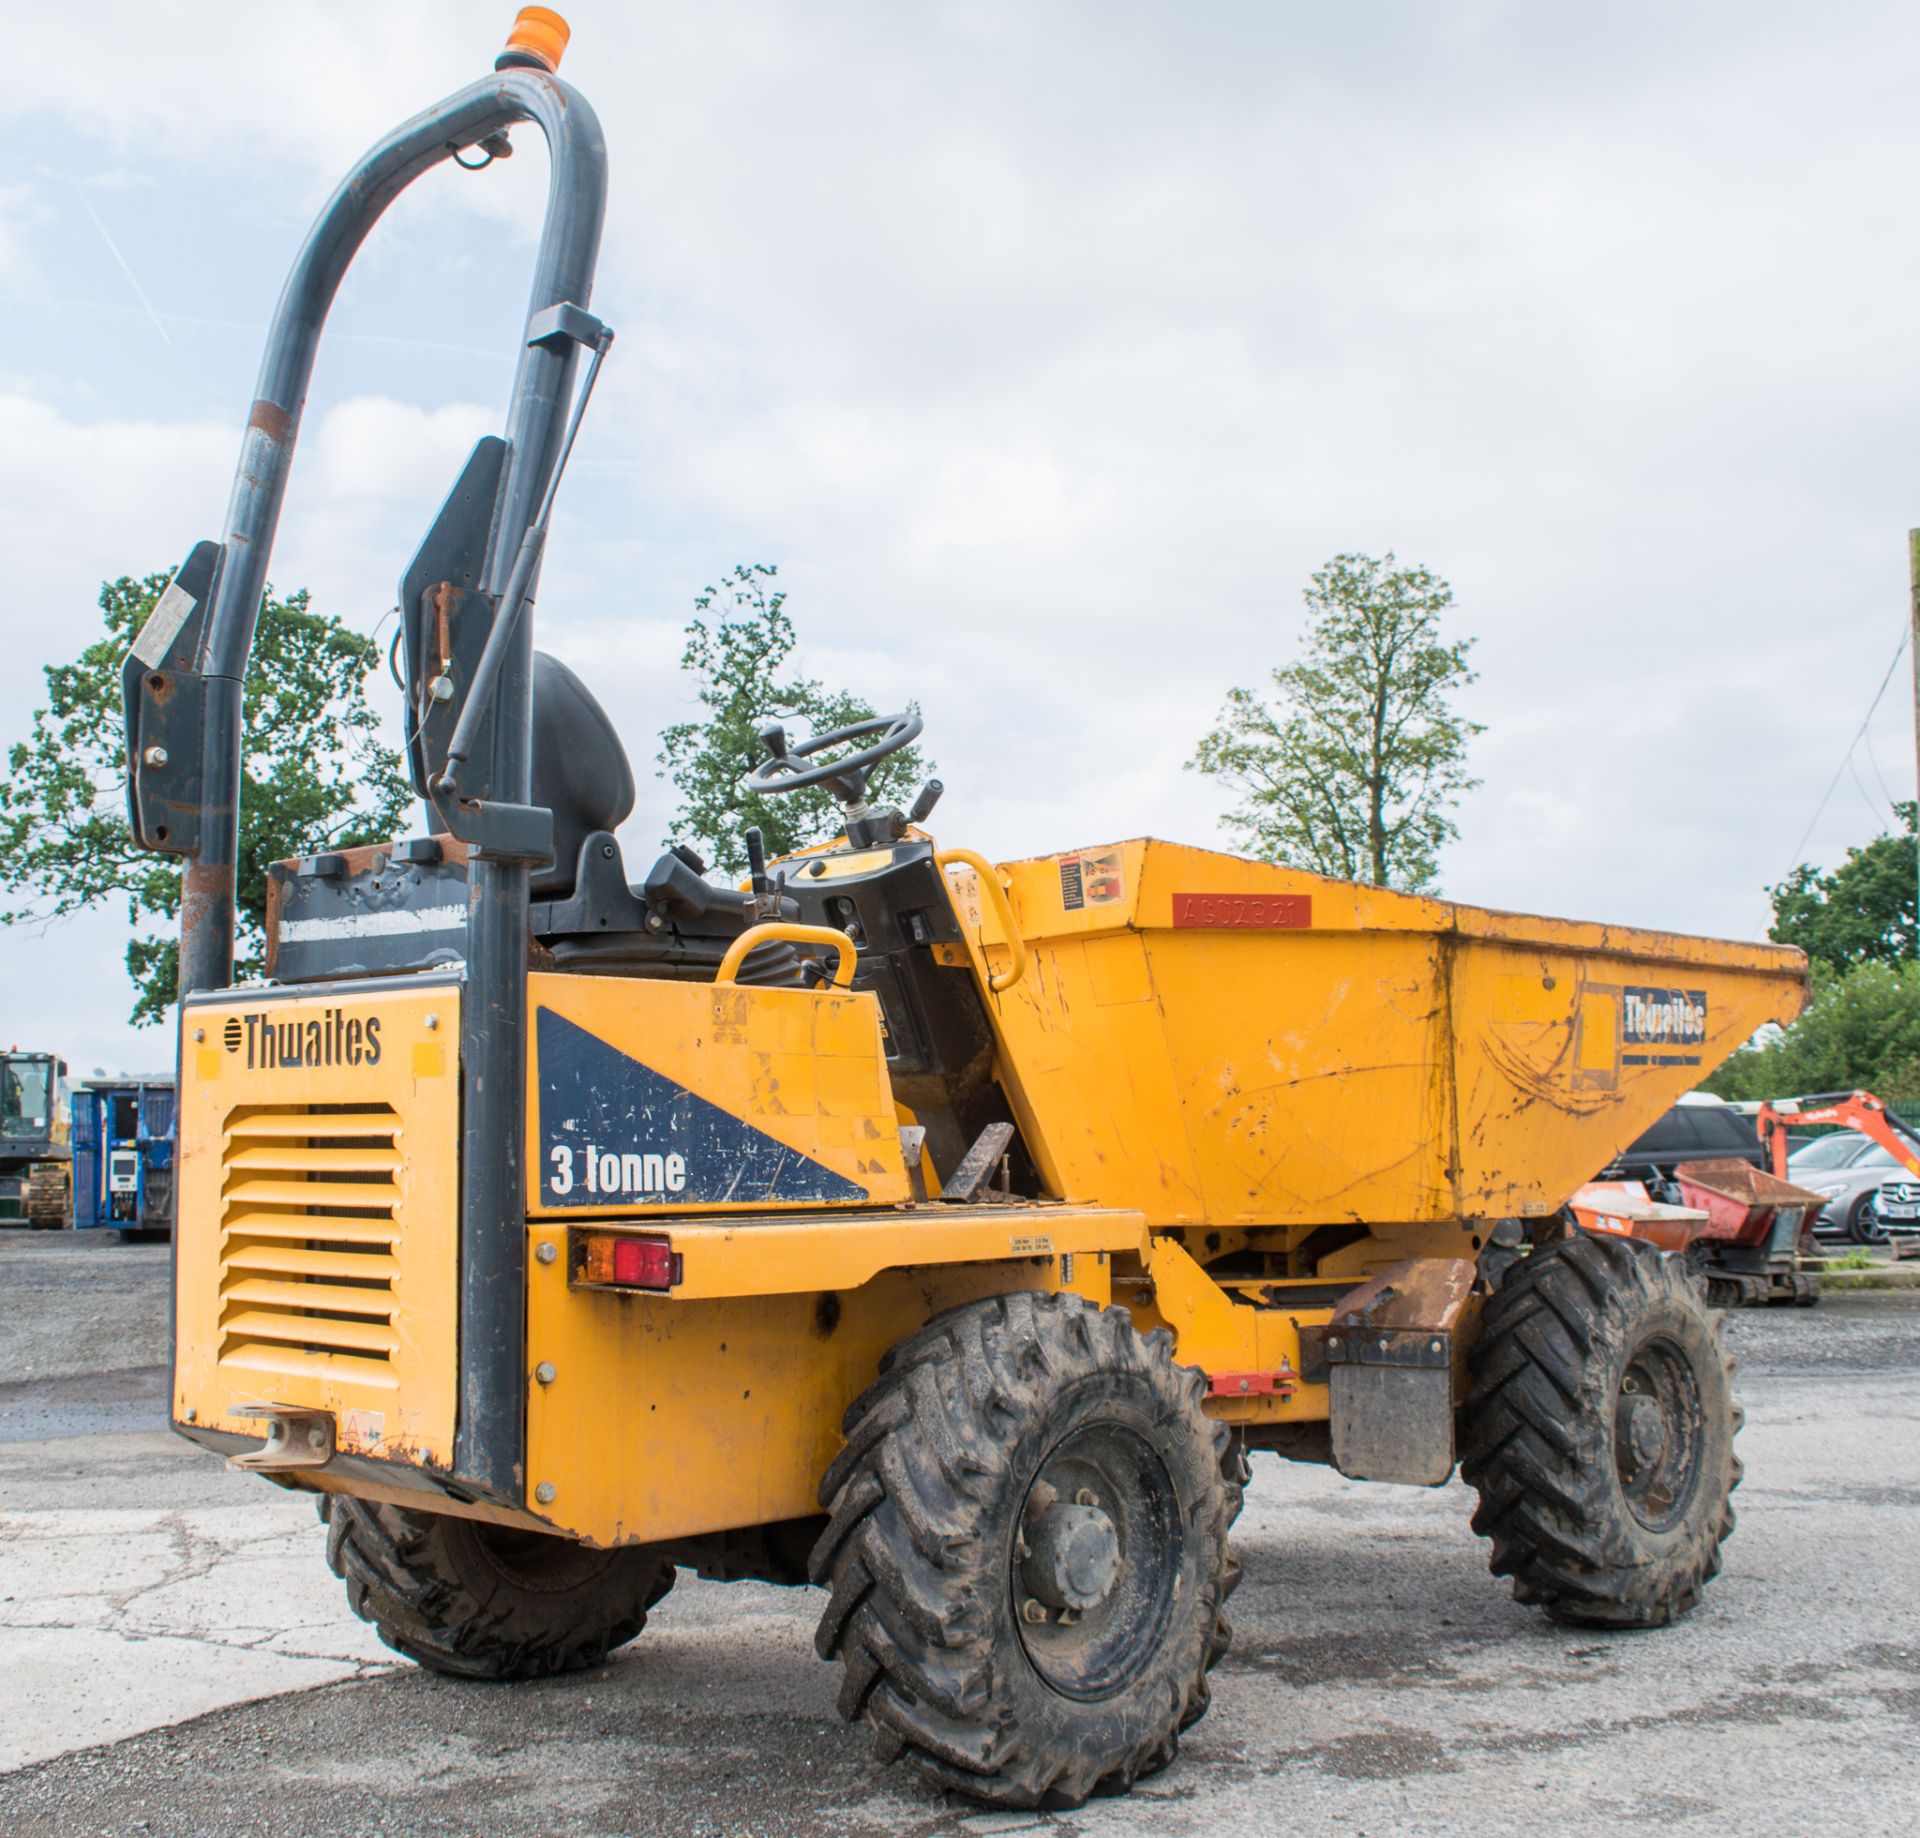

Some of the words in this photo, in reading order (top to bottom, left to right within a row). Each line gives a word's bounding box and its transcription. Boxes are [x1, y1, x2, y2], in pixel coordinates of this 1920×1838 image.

[244, 1008, 381, 1069] Thwaites
[1625, 995, 1704, 1035] Thwaites
[551, 1145, 573, 1195] 3
[586, 1145, 685, 1192] tonne
